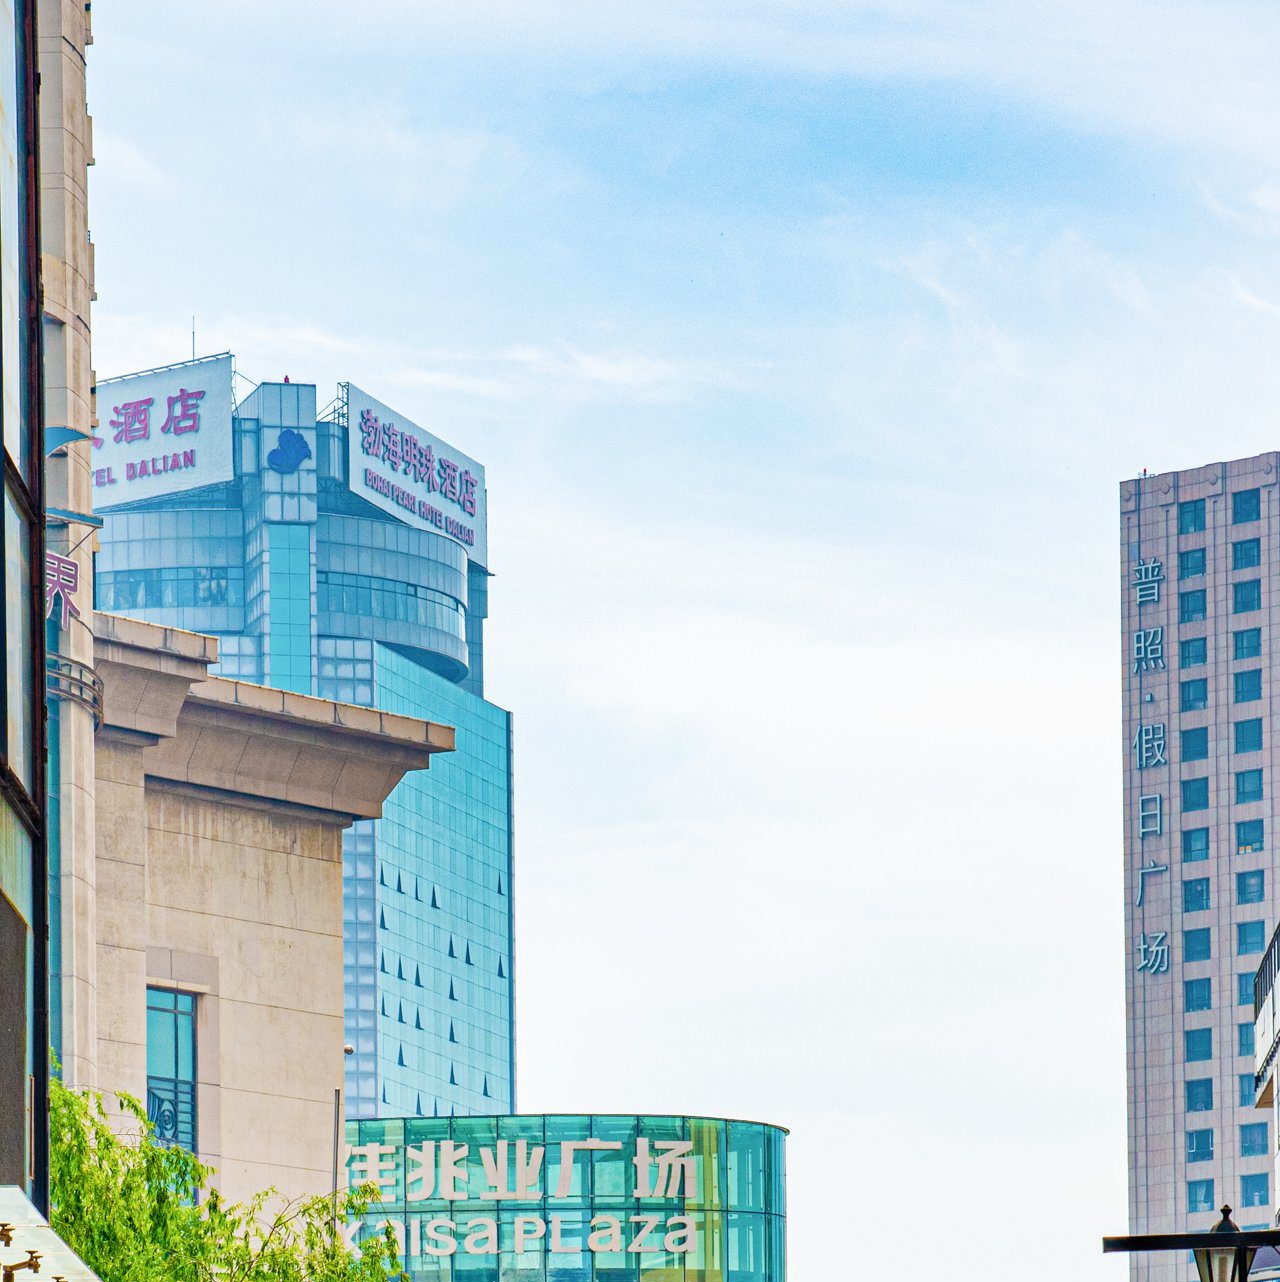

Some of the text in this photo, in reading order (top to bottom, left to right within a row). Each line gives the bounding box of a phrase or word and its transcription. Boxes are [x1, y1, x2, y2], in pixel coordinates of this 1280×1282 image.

[92, 388, 206, 448] 酒店
[92, 449, 195, 487] EL DALIAN
[360, 409, 478, 517] 渤海明珠酒店
[365, 468, 474, 546] BOHAI PEARL HOTEL DALIAN
[345, 1138, 696, 1201] 佳兆业广场
